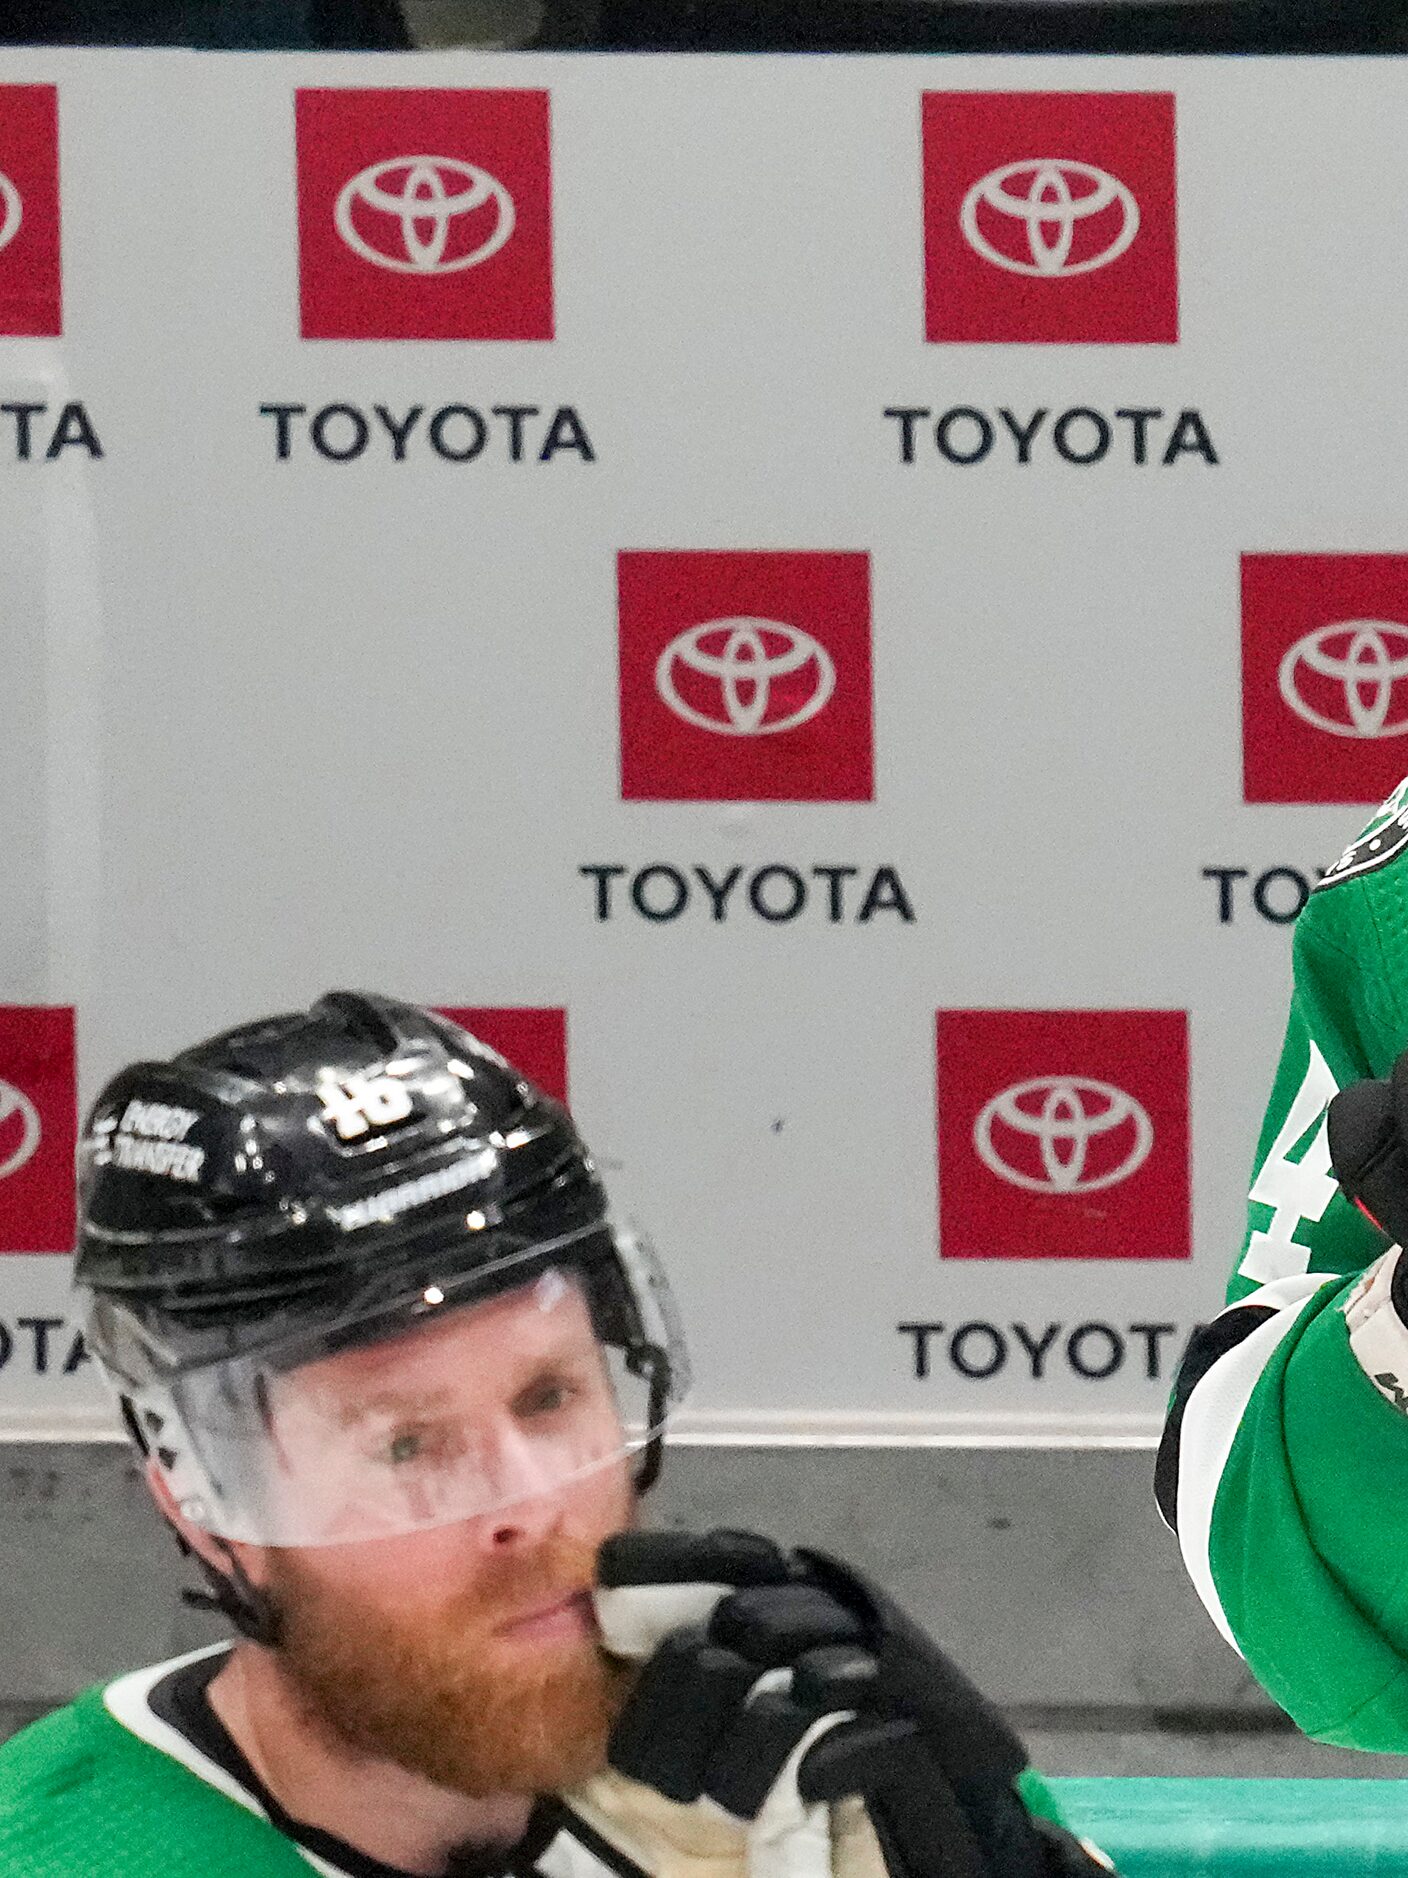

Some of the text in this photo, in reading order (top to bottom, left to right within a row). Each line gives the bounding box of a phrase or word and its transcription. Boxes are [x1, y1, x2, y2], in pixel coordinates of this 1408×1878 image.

[259, 403, 596, 463] TOYOTA
[883, 406, 1220, 466] TOYOTA
[578, 864, 916, 923] TOYOTA
[896, 1320, 1207, 1378] TOYOT
